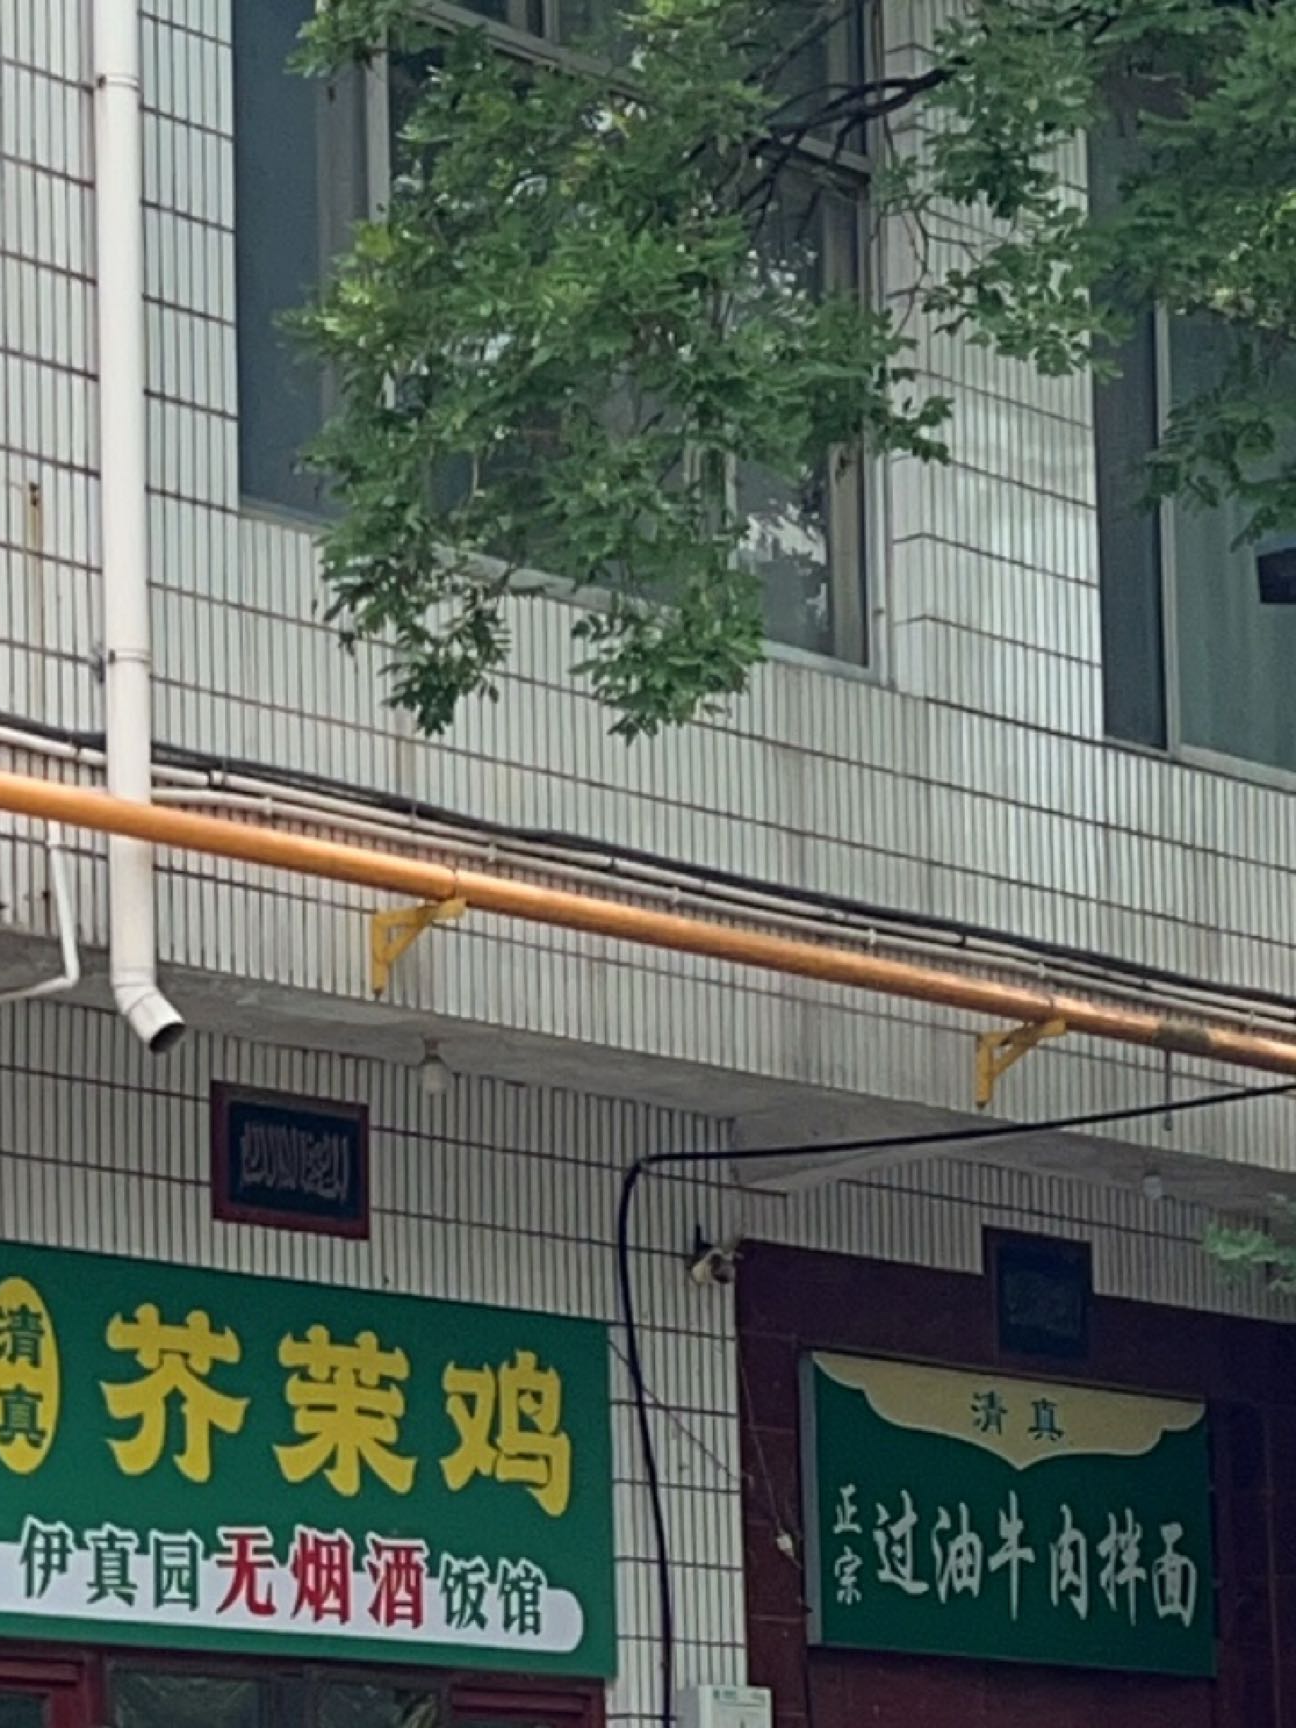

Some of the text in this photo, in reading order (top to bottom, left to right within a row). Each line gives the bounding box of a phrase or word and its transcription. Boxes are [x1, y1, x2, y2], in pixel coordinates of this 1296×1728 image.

[100, 1303, 571, 1516] 芥茉鸡
[970, 1390, 1065, 1442] 清真
[18, 1519, 544, 1636] 伊真园无烟酒饭馆
[833, 1483, 864, 1606] 正宗
[872, 1489, 1198, 1628] 过油牛肉拌面
